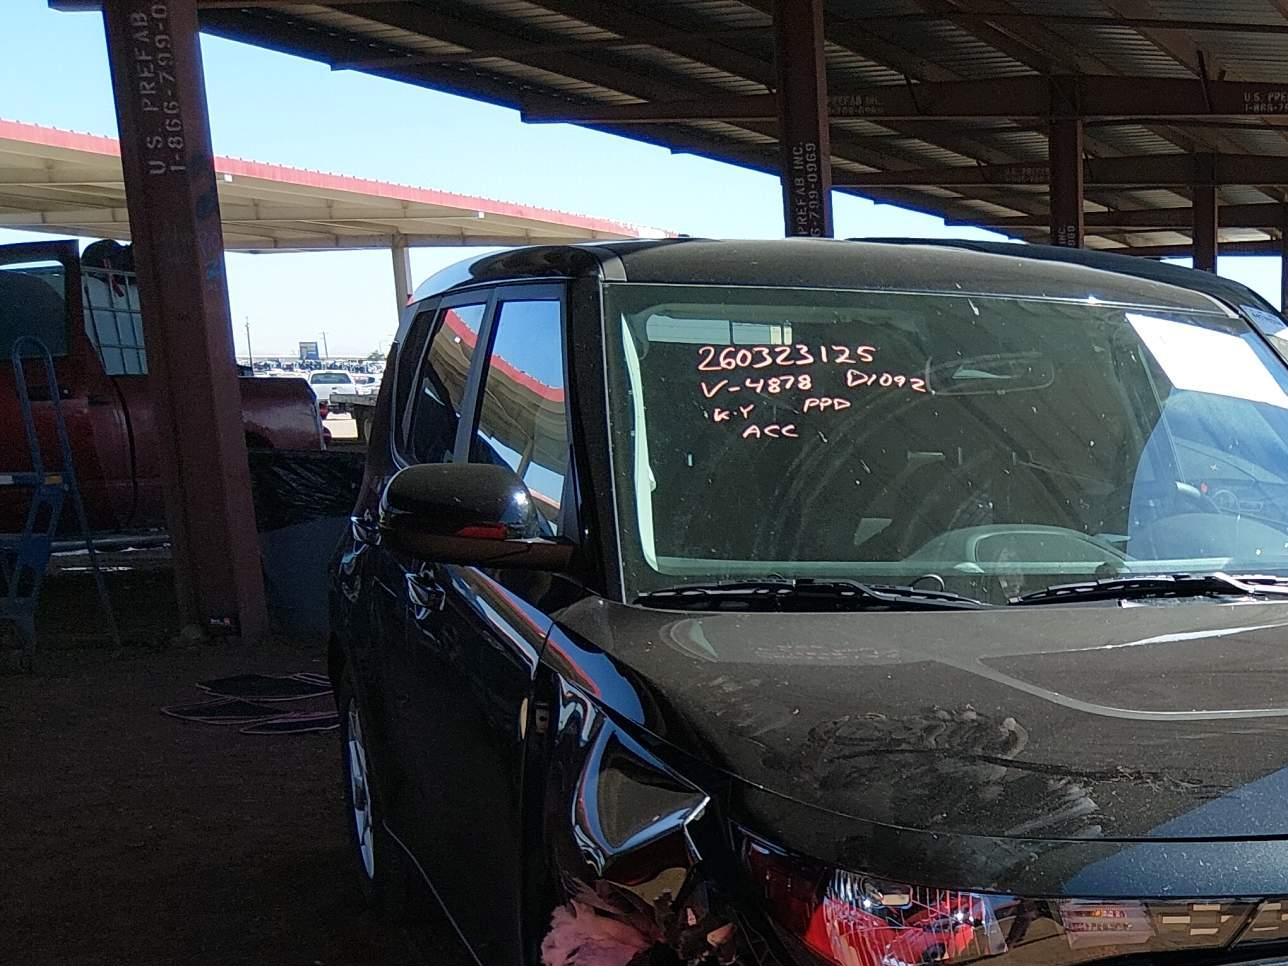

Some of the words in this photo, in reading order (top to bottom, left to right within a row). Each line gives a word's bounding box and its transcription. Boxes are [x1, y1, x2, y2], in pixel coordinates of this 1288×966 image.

[129, 10, 160, 111] PREFAB
[151, 1, 186, 172] 1-866-799-0
[697, 344, 877, 371] 260323125
[700, 374, 813, 398] V-4878
[803, 398, 851, 413] PPD
[742, 424, 799, 439] ACC
